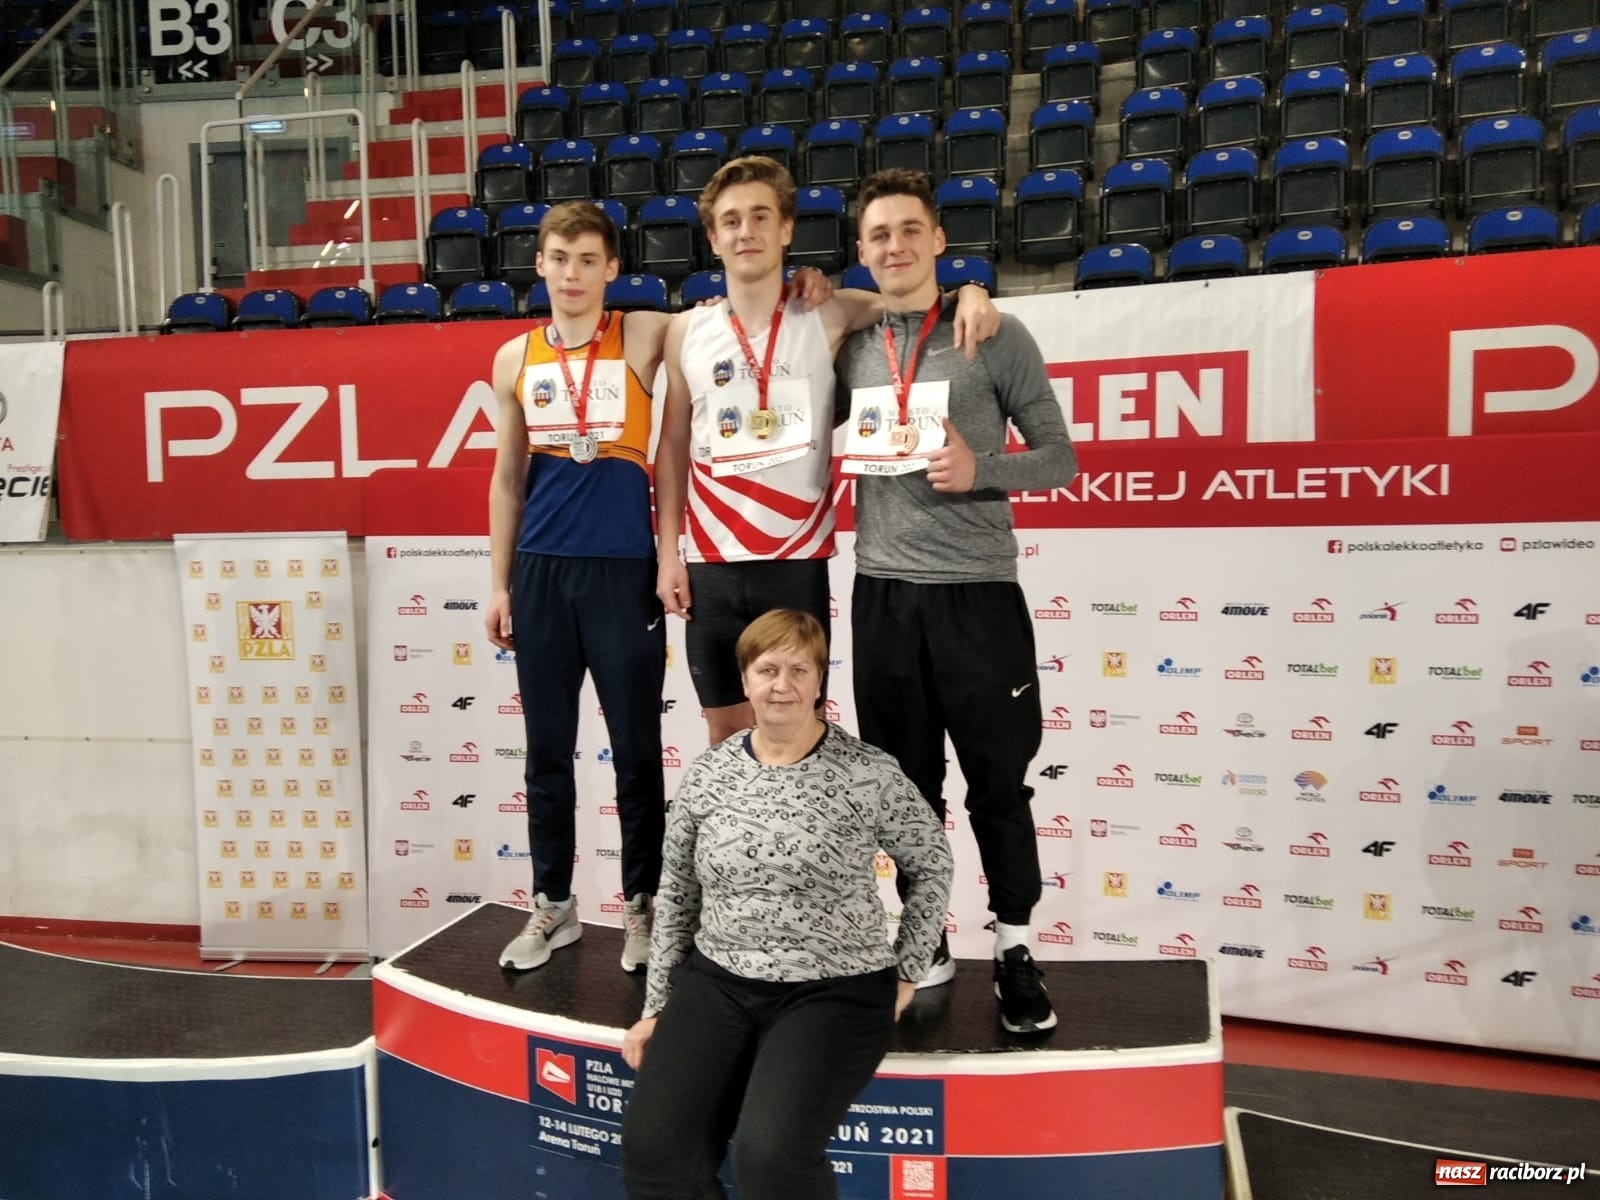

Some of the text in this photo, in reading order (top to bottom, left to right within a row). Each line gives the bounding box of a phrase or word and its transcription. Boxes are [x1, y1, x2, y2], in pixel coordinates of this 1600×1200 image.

[149, 0, 233, 56] B3
[271, 0, 360, 50] C3
[1048, 367, 1225, 442] LEN
[144, 379, 500, 483] PZLA
[1201, 463, 1450, 503] ATLETYKI
[1347, 537, 1595, 553] polskalekkoatletyka pzlawideo
[1220, 606, 1270, 616] 4MOVE
[1513, 602, 1551, 620] 4F
[241, 641, 292, 658] PZLA
[451, 696, 476, 710] 4F
[1042, 721, 1070, 729] RLEN
[1364, 722, 1400, 739] 4F
[1039, 764, 1068, 780] 4F
[452, 794, 476, 808] 4F
[1361, 840, 1397, 857] 4F
[1501, 970, 1539, 987] 4F
[586, 1059, 614, 1075] PZLA
[586, 1093, 626, 1114] TOR
[900, 1106, 934, 1117] POLSKI
[538, 1115, 567, 1132] 12-14
[568, 1122, 610, 1143] LUTEGO
[879, 1126, 934, 1146] 2021
[538, 1130, 602, 1156] Arena Toruń
